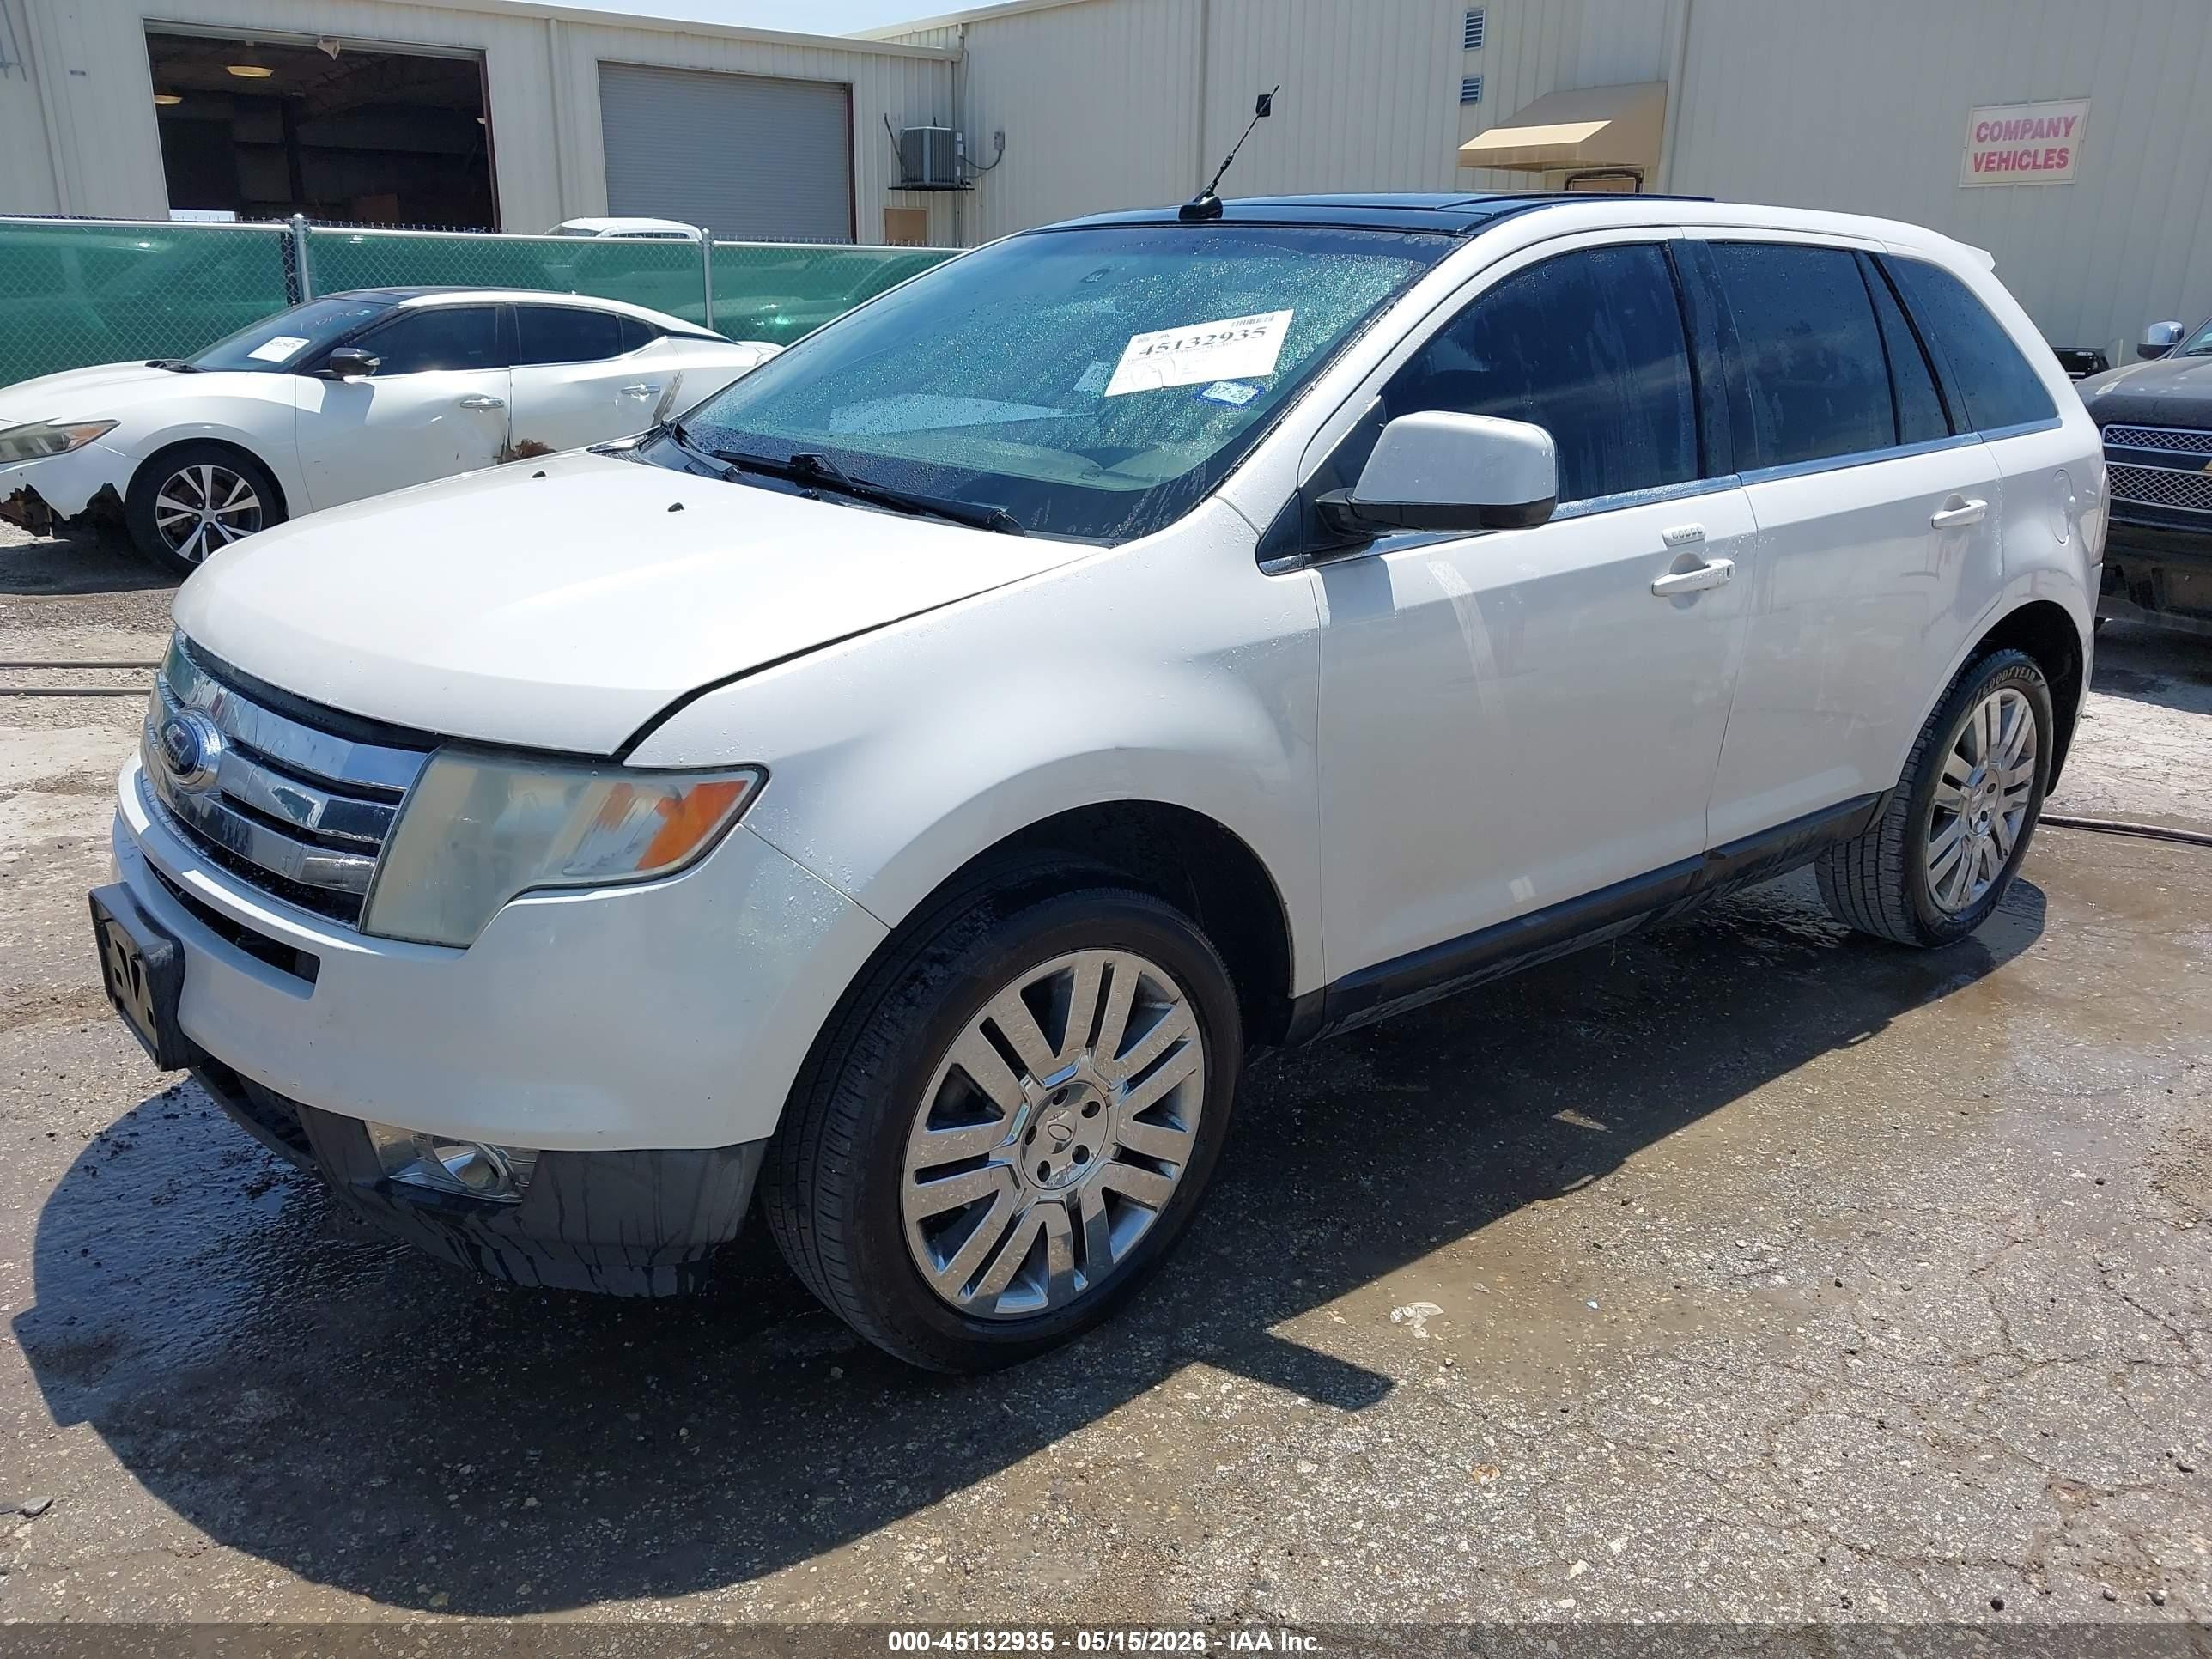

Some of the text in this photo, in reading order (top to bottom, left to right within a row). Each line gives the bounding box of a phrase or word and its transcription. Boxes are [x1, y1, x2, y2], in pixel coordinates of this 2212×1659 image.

[1976, 115, 2078, 143] COMPANY
[1973, 147, 2070, 172] VEHICLES
[1139, 325, 1268, 356] 45132935
